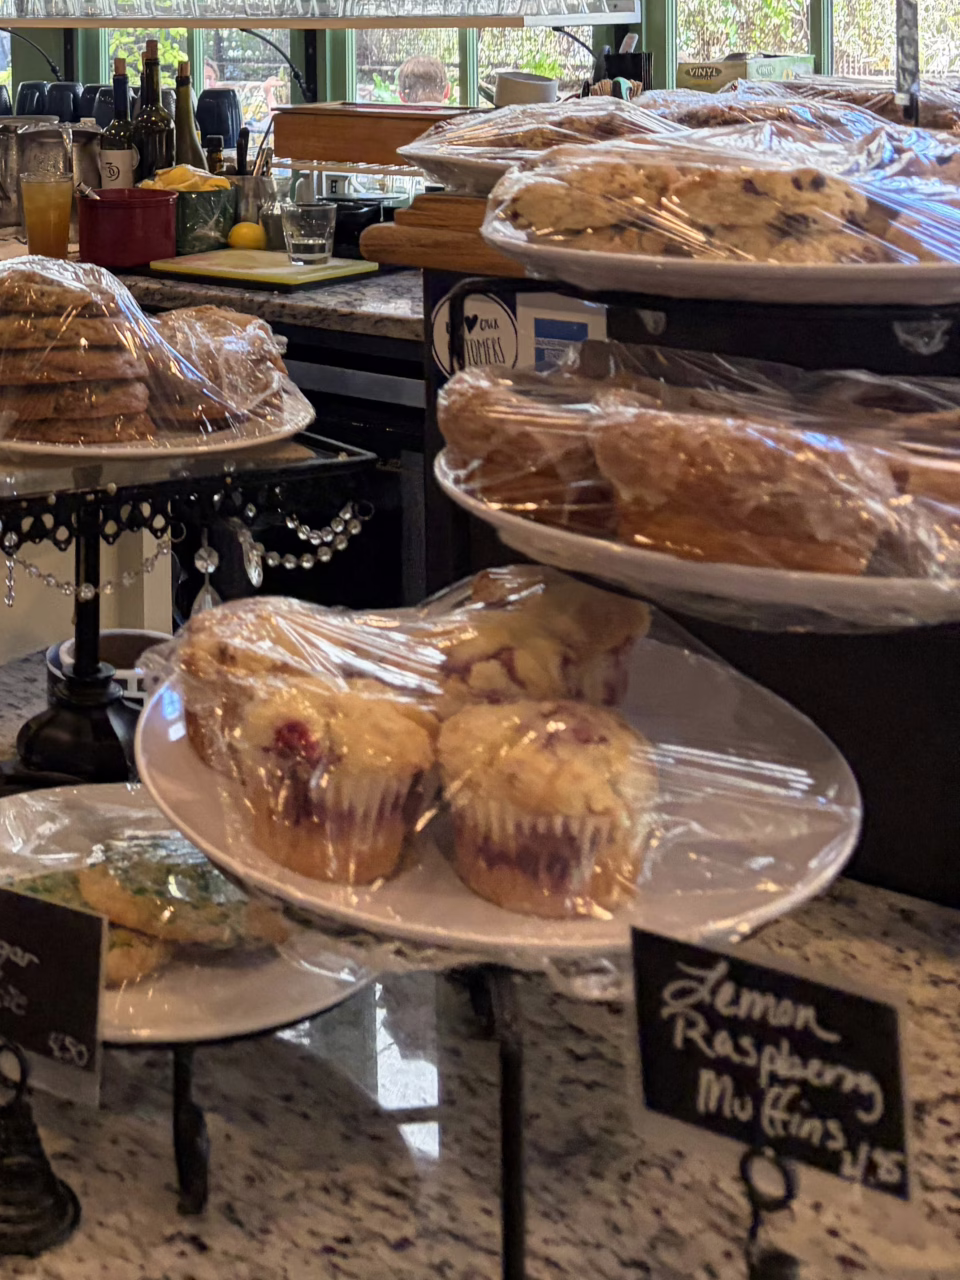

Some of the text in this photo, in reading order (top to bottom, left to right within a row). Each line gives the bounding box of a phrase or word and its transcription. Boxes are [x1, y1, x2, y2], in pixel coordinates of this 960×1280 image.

[689, 68, 717, 76] VINYL
[662, 960, 842, 1043] Lemon
[660, 1006, 885, 1125] Raspberry
[696, 1068, 847, 1151] Muffins
